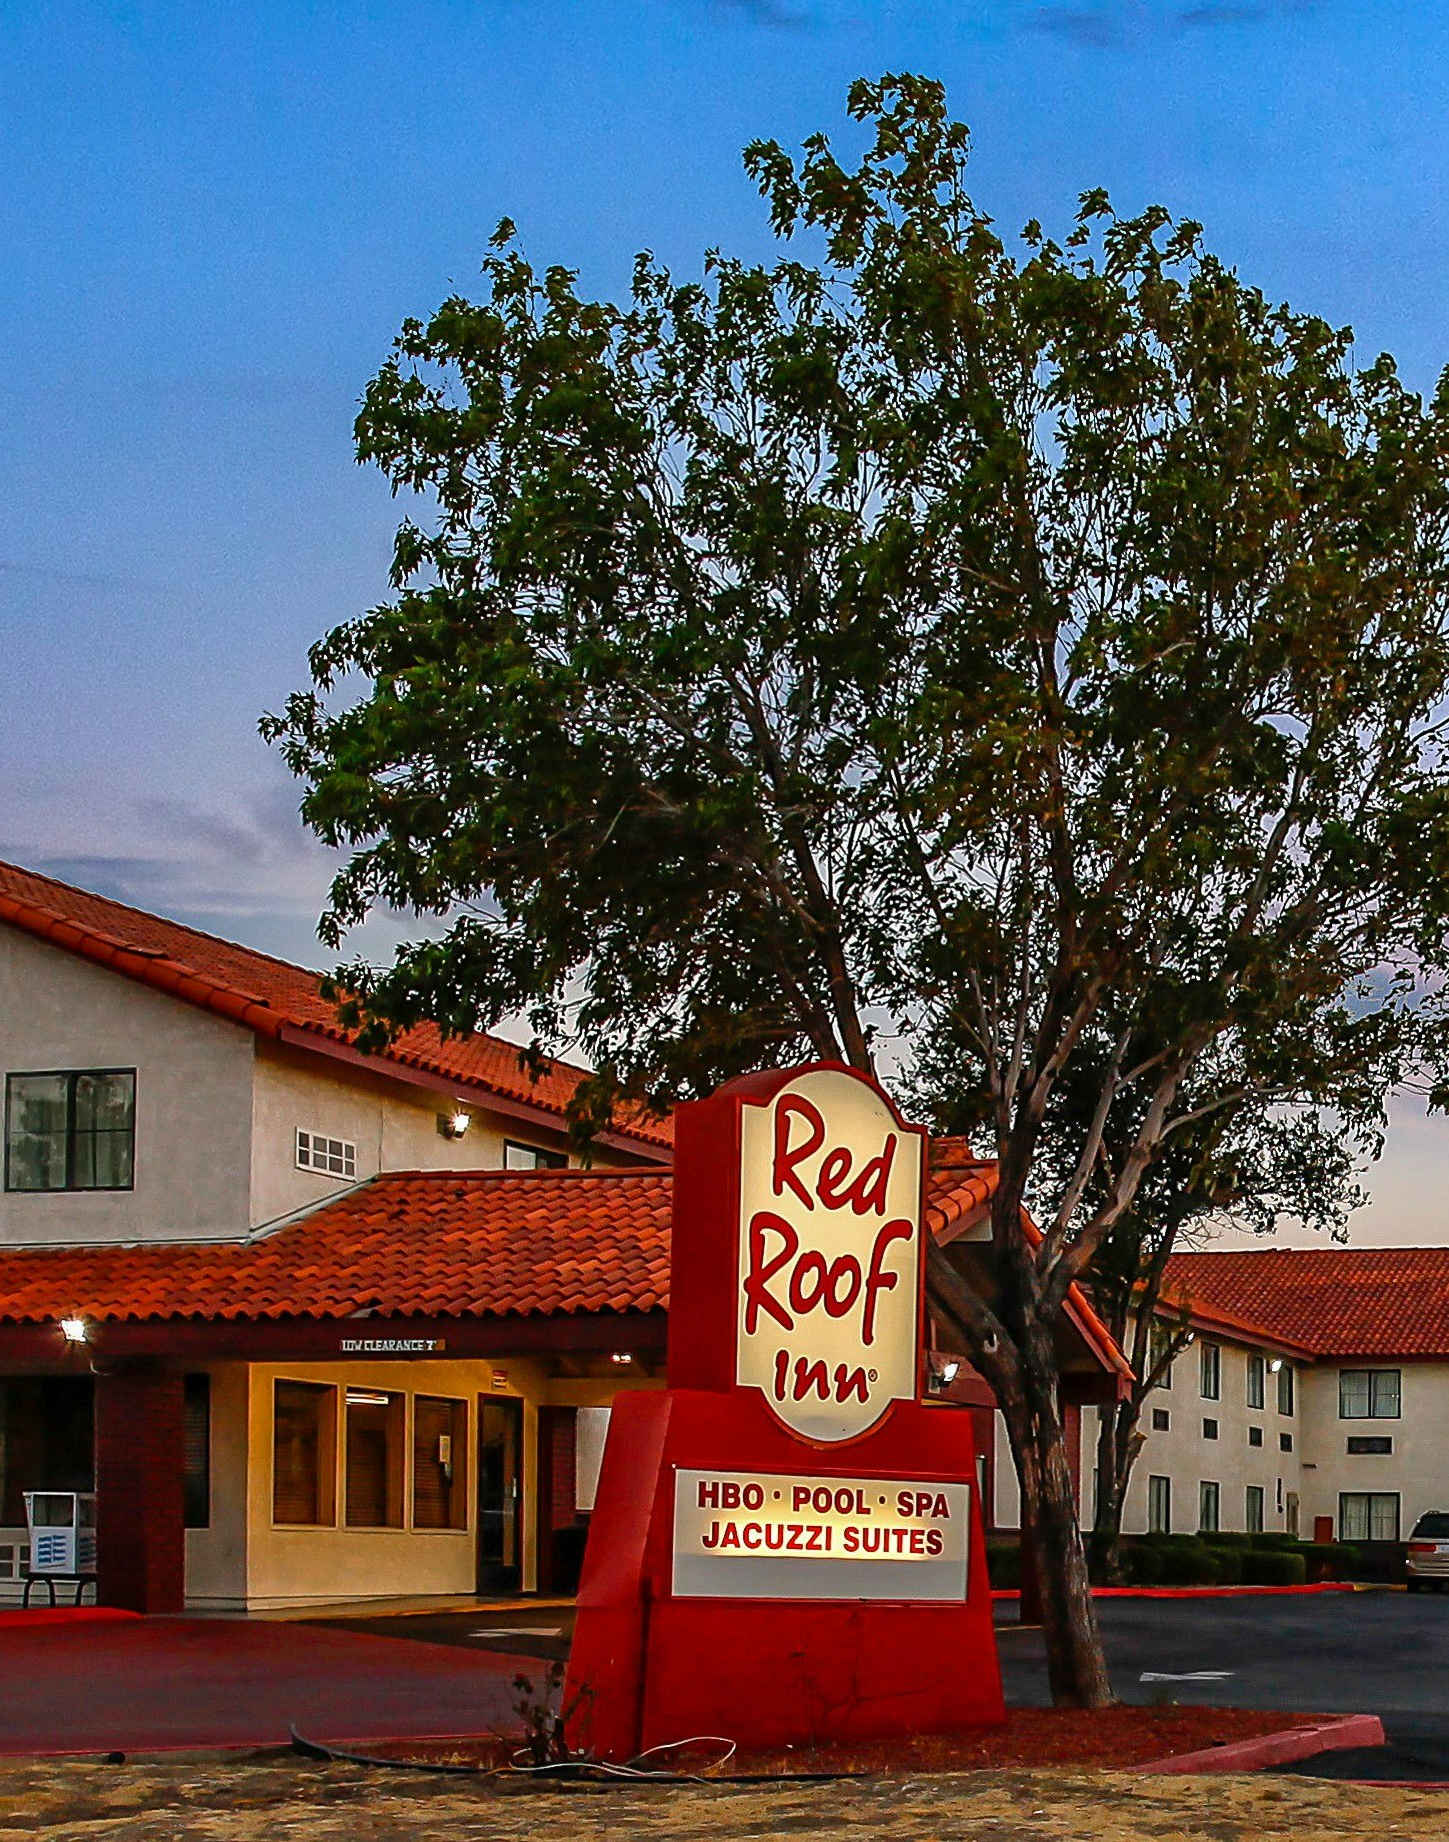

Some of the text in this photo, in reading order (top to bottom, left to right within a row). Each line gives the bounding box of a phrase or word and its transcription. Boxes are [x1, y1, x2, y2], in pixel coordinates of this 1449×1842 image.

[773, 1093, 898, 1216] Red
[744, 1211, 913, 1346] Roof
[364, 1340, 424, 1351] CLEARANCE
[698, 1481, 950, 1518] HBO POOL SPA
[702, 1521, 943, 1555] JACUZZI SUITES
